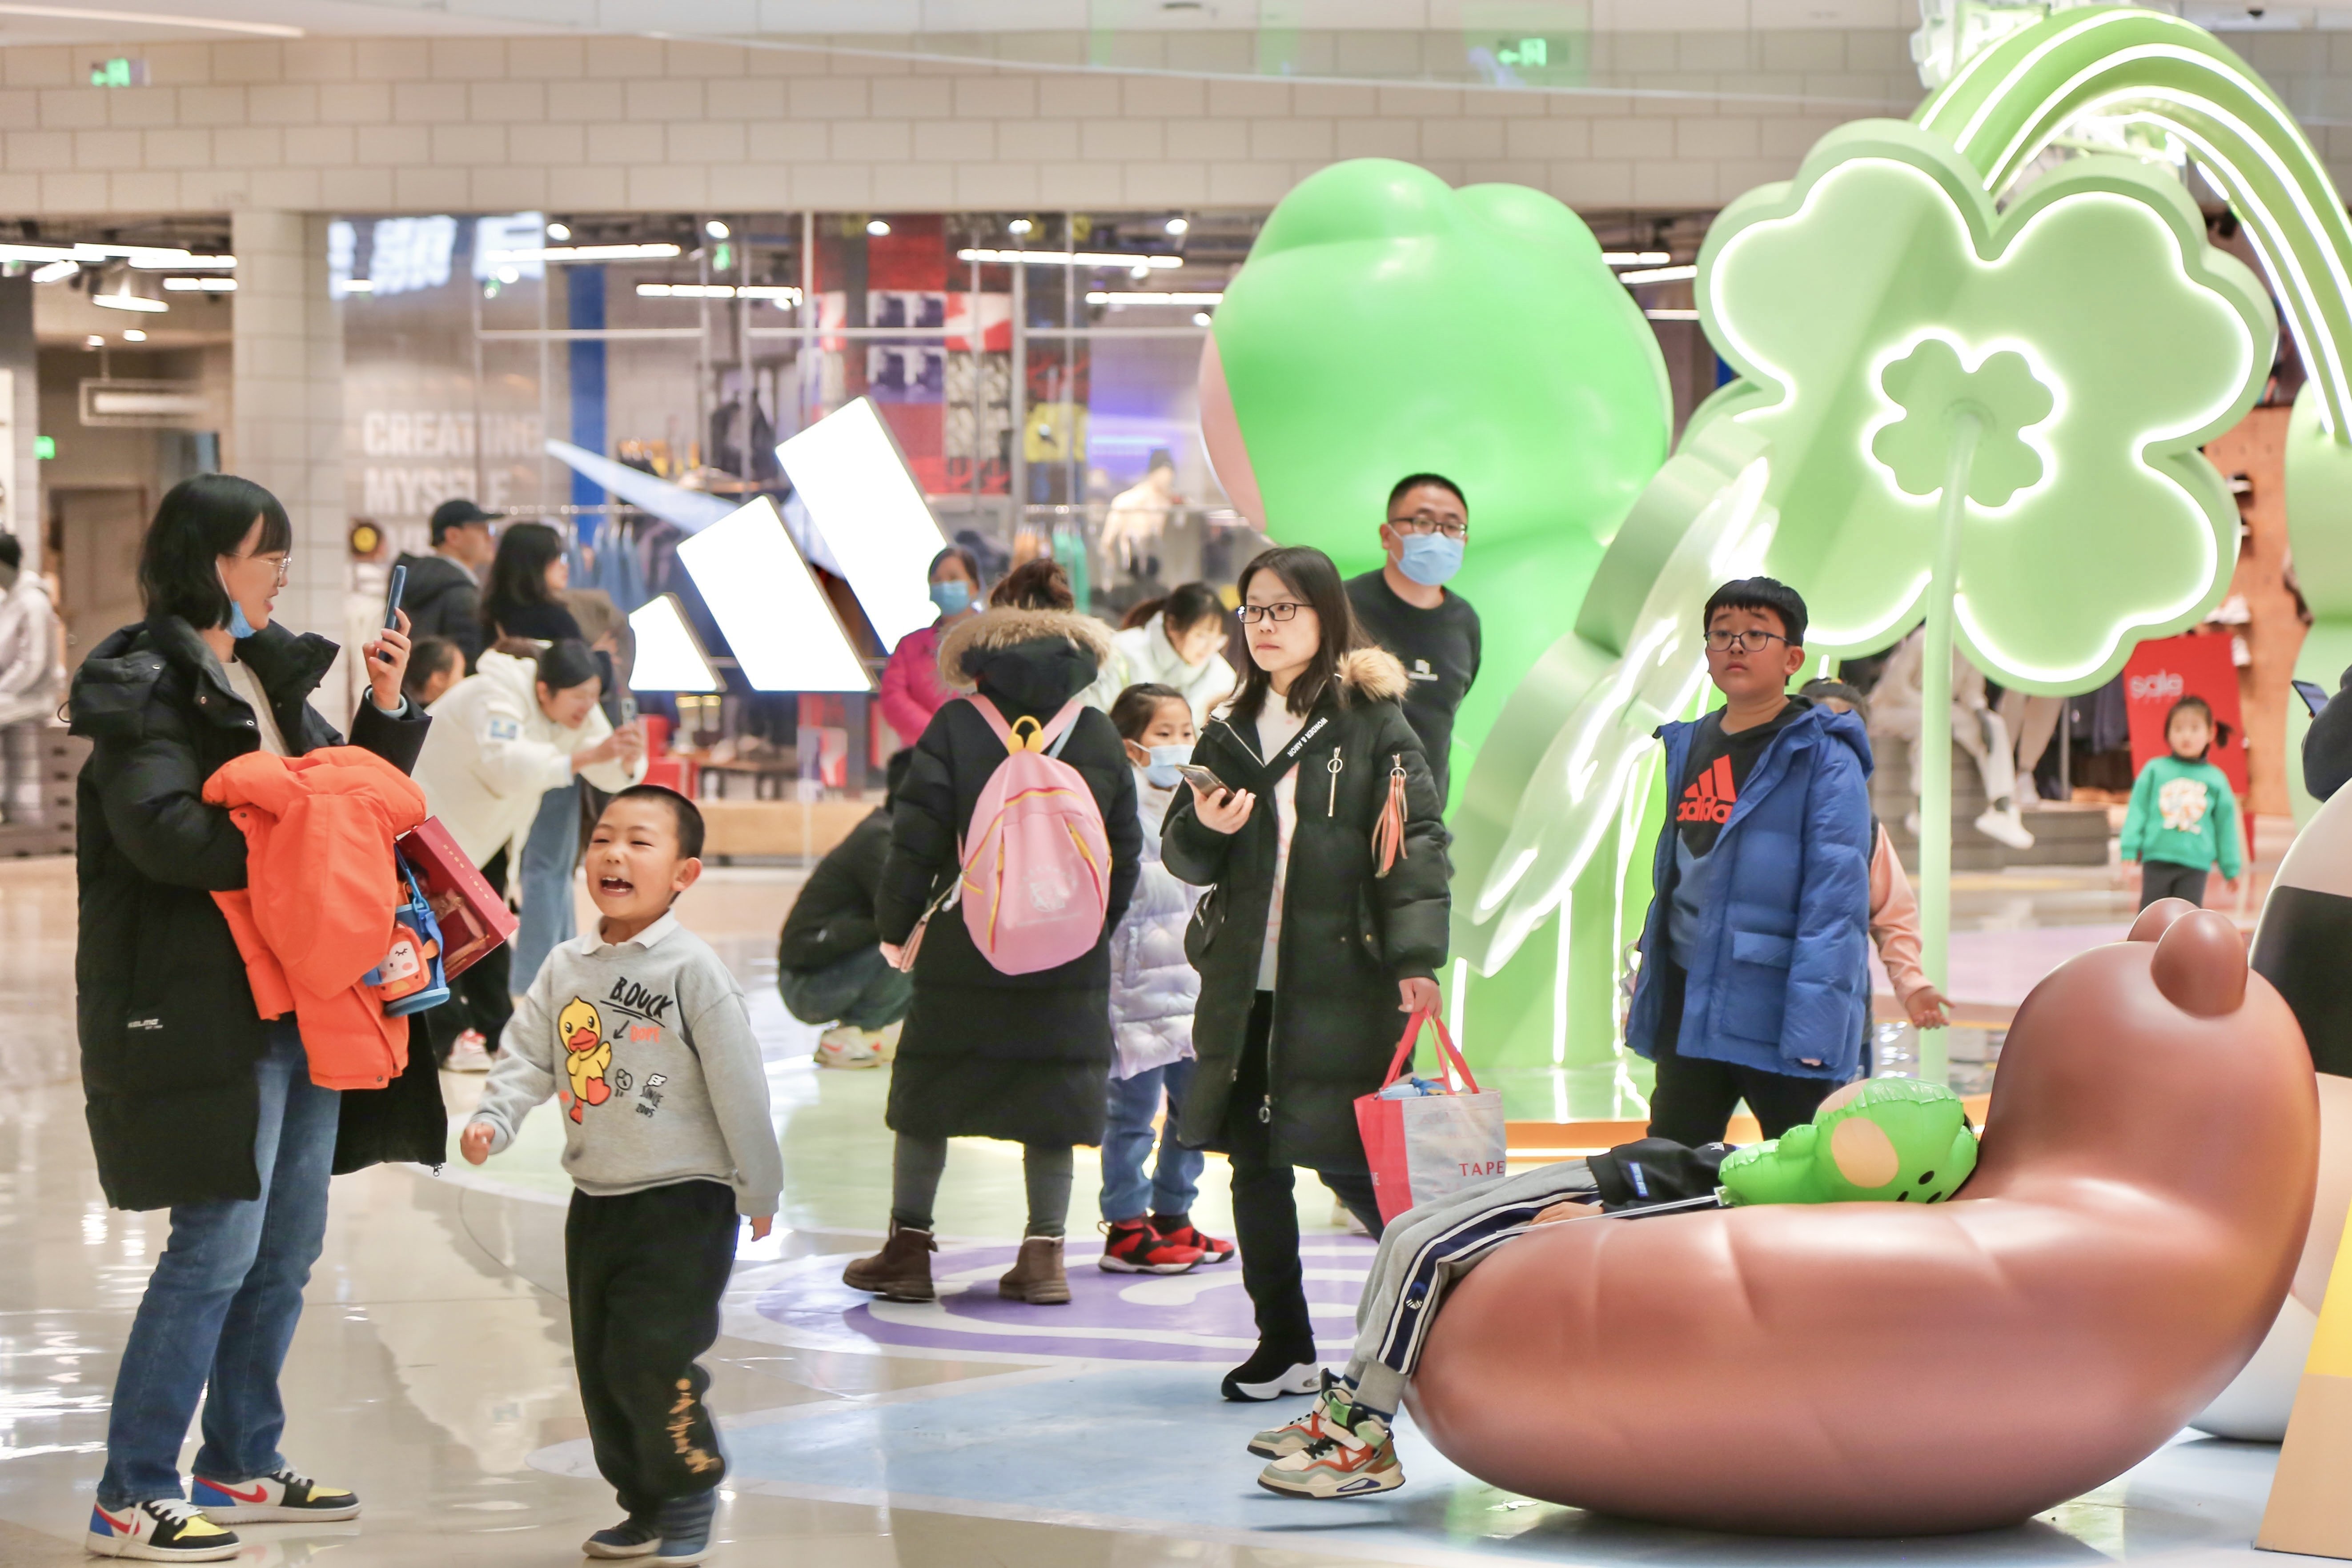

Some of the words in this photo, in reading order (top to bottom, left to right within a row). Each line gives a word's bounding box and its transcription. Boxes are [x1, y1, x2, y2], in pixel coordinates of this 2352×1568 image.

[363, 411, 543, 458] CREATING
[2131, 668, 2183, 699] sale
[1305, 717, 1328, 739] WONDER
[1287, 740, 1303, 757] AMOR
[1676, 795, 1734, 824] adida
[610, 977, 673, 1019] B.DUCK
[630, 1025, 660, 1043] DOPE
[1458, 1161, 1505, 1177] TAPE
